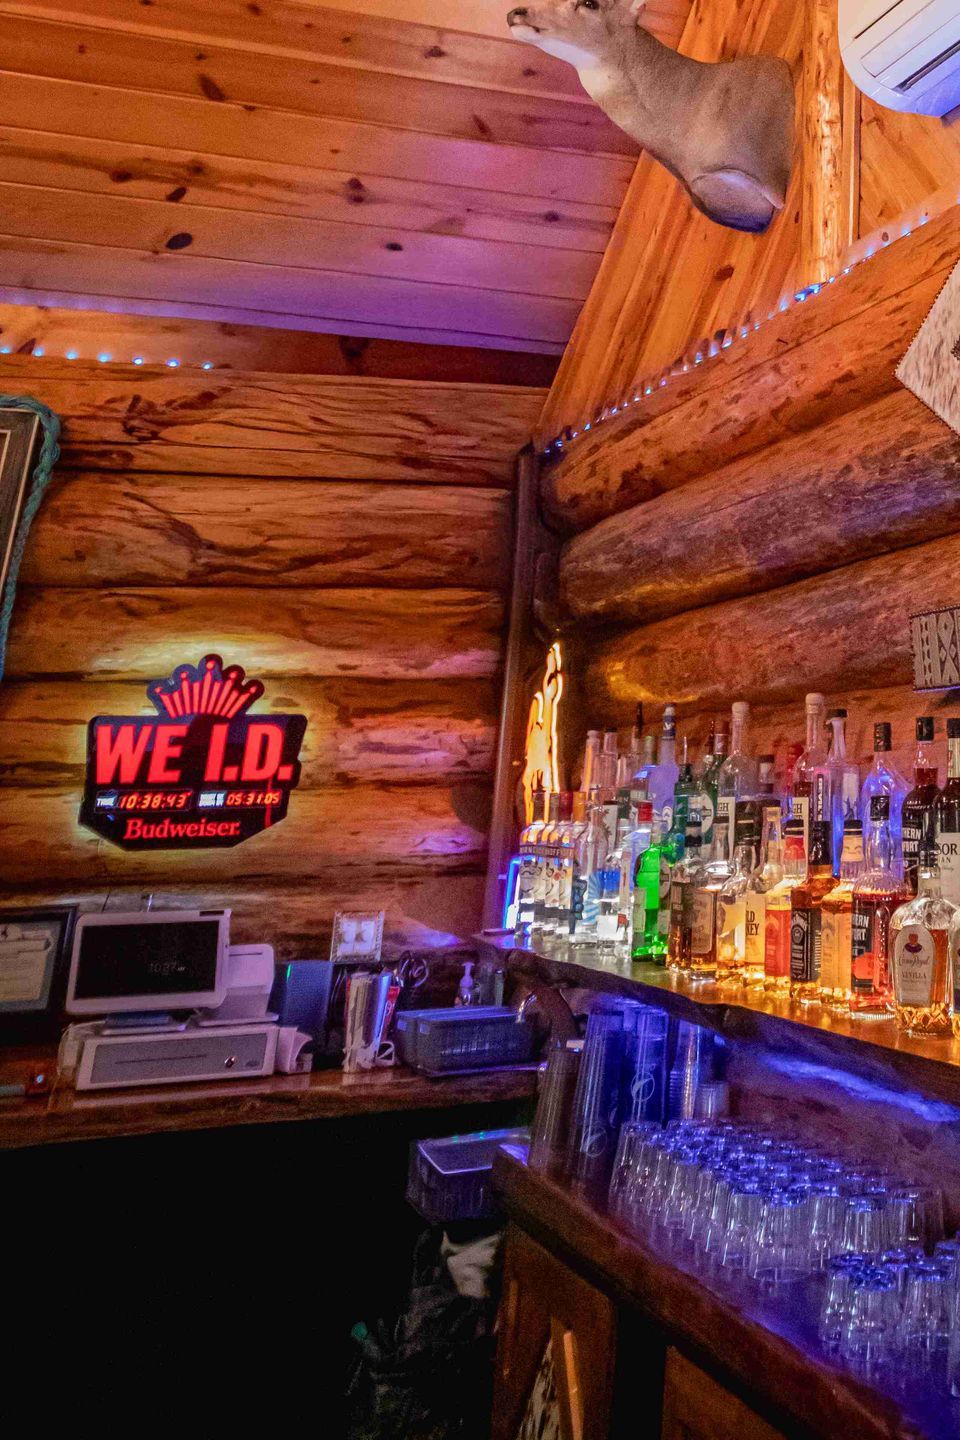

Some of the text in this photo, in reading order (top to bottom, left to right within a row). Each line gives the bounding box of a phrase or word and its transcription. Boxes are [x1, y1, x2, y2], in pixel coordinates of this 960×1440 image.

[96, 723, 294, 784] WE I.D.
[119, 791, 187, 809] 10:38:43
